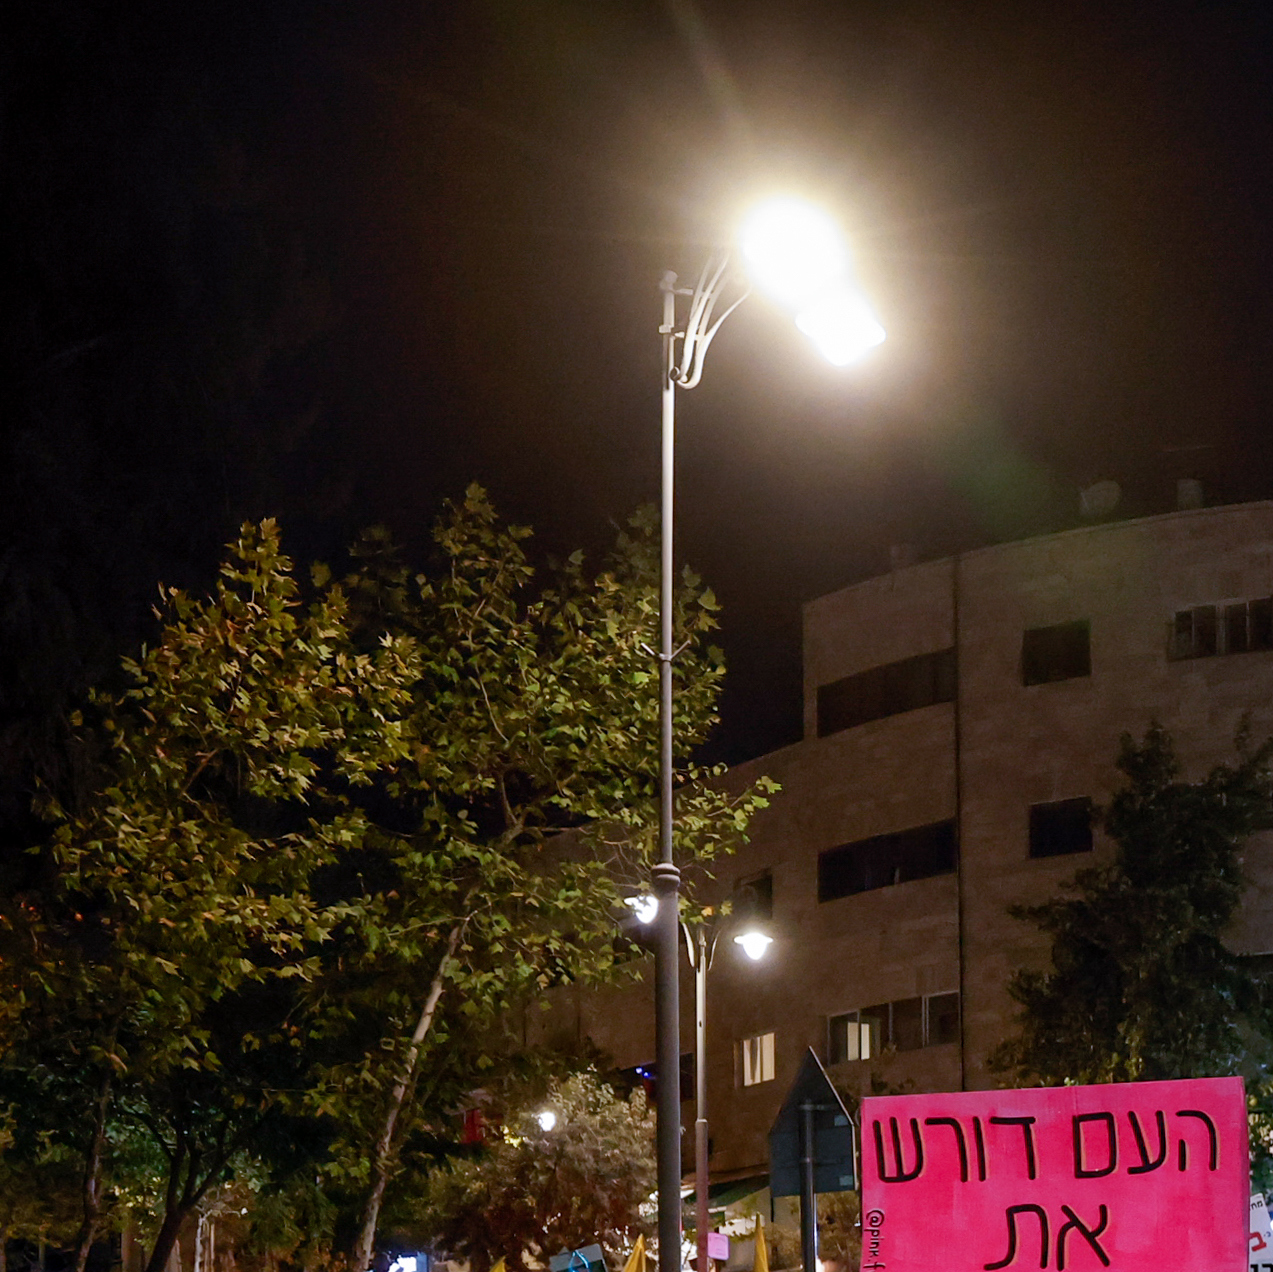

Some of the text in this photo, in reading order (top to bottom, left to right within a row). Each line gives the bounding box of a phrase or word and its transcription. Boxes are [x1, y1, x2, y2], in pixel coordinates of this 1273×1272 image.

[873, 1109, 1219, 1183] העם דורש
[982, 1203, 1112, 1272] את
